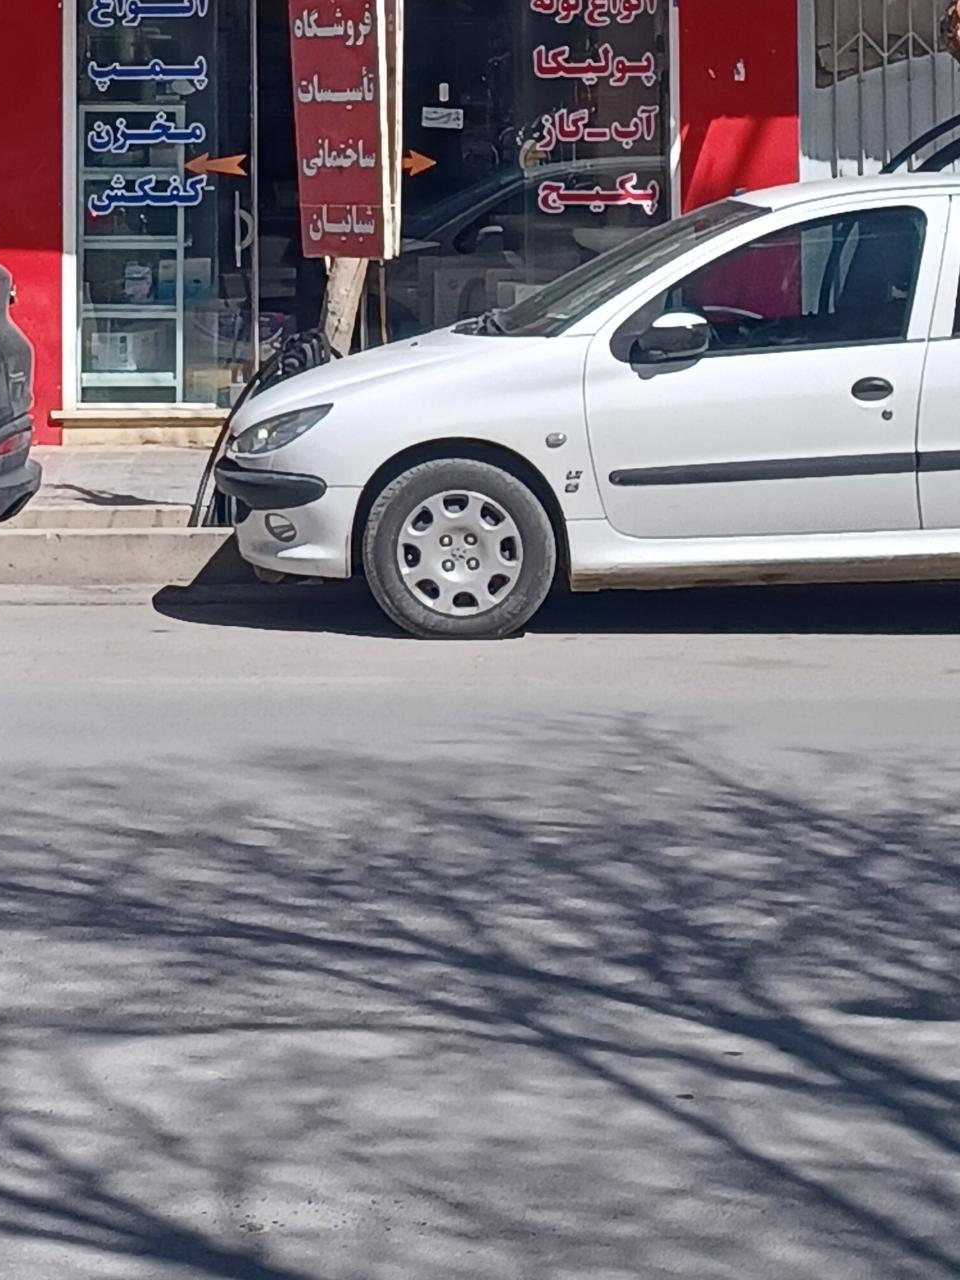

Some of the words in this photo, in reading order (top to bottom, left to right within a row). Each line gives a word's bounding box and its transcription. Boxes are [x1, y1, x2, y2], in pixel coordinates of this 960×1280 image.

[293, 3, 372, 46] فروشگاه
[87, 55, 208, 92] پمپ
[533, 43, 655, 87] پولیکا
[87, 111, 206, 153] مخزن
[302, 138, 376, 177] ساختمانی
[87, 174, 208, 215] کفکش
[537, 172, 660, 215] پکیج
[308, 203, 375, 242] شبانیان
